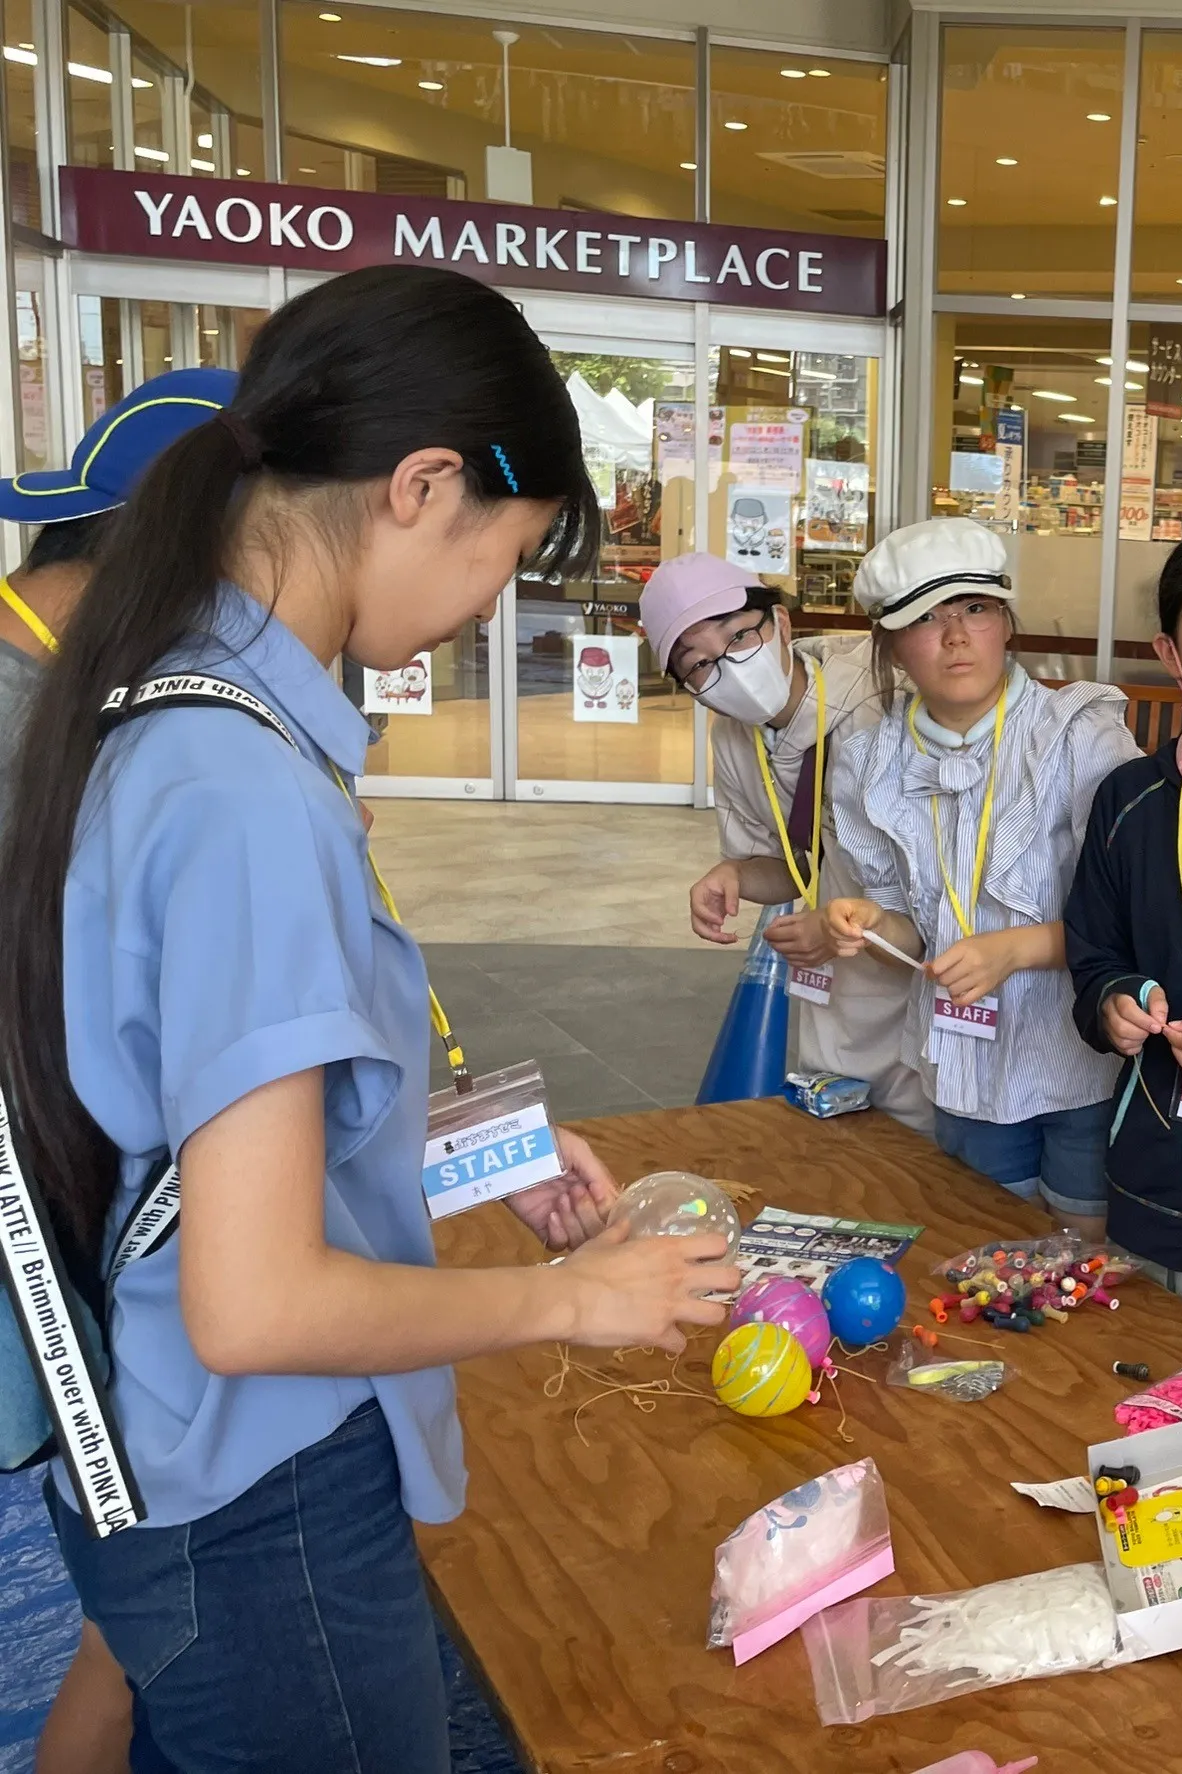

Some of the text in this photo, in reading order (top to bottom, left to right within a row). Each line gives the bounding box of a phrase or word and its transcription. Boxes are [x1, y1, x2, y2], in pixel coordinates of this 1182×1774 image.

[135, 190, 825, 294] YAOKO MARKETPLACE
[594, 603, 628, 613] YAOKO
[151, 678, 205, 695] PINK
[211, 682, 260, 708] with
[796, 970, 828, 989] STAFF
[439, 1134, 537, 1187] STAFF
[135, 1208, 165, 1241] with
[22, 1258, 68, 1362] Brimming
[56, 1363, 85, 1406] over
[72, 1408, 106, 1456] with
[86, 1456, 121, 1508] PINK
